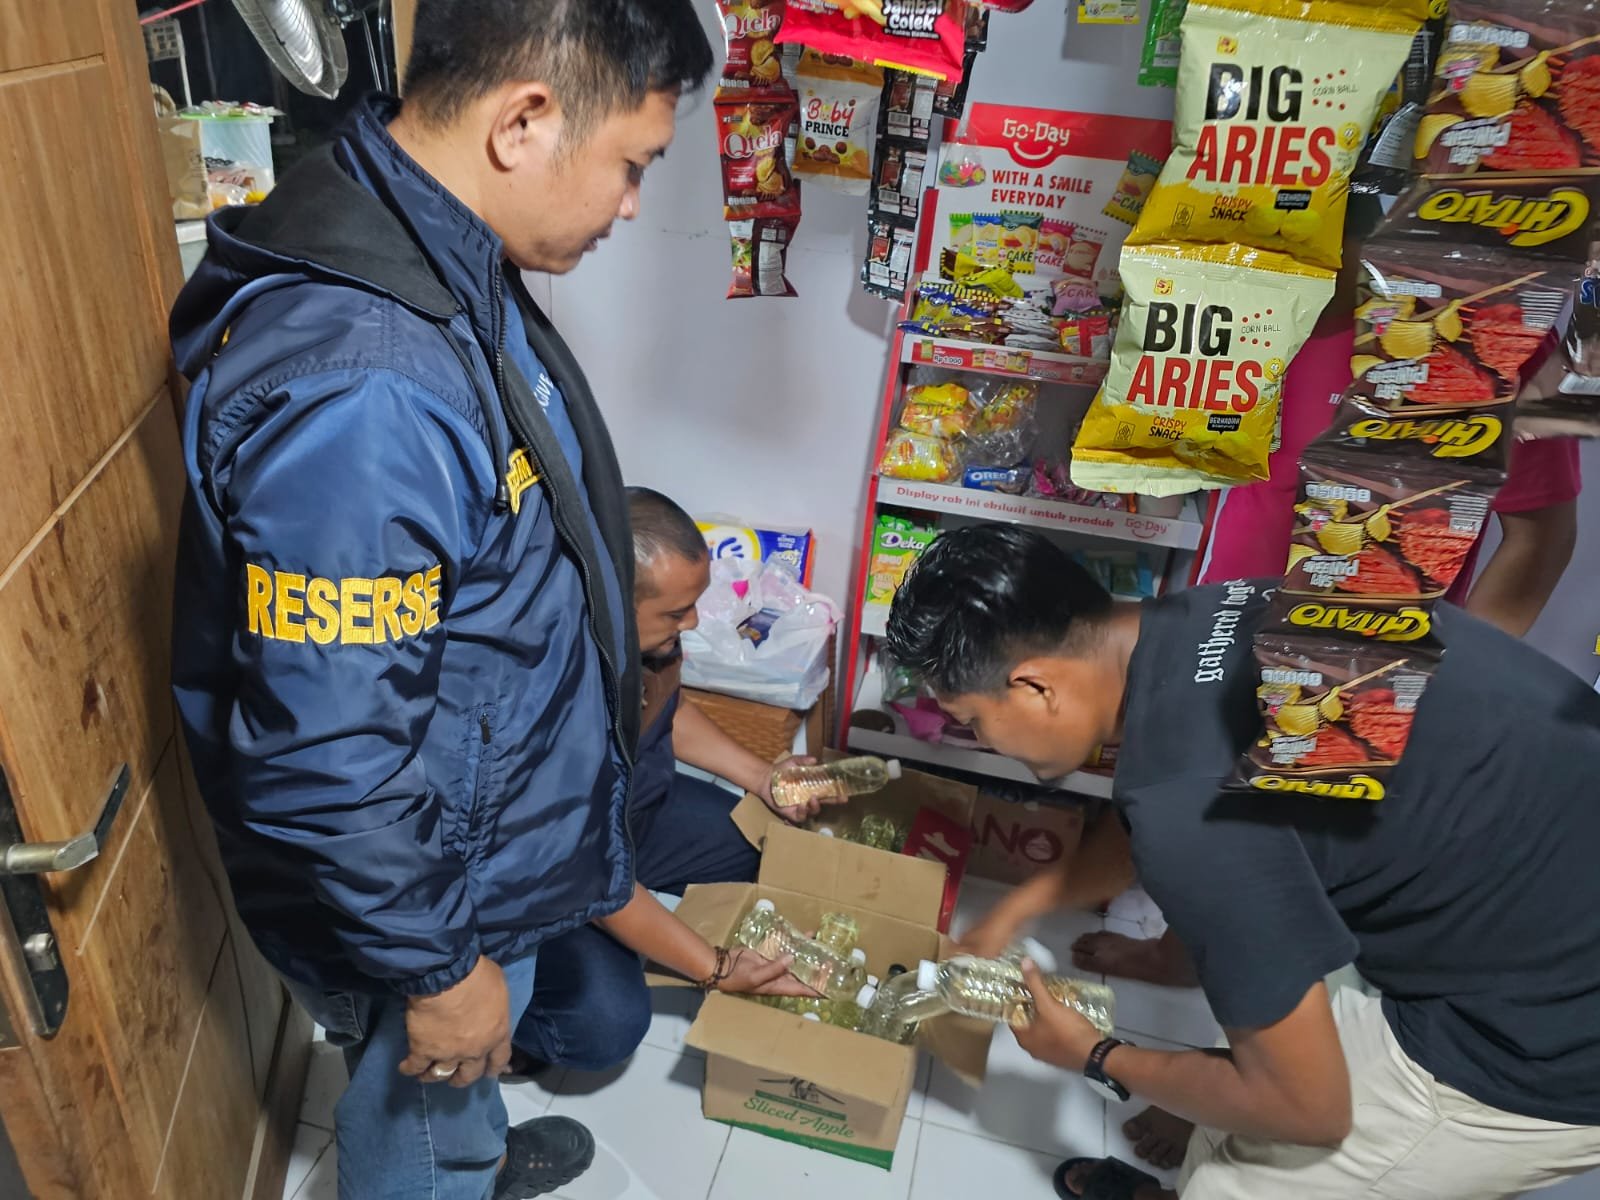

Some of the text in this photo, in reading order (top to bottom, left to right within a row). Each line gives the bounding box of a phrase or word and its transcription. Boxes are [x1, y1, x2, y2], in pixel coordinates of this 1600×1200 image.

[723, 11, 781, 40] Qtela
[888, 14, 935, 31] Colek
[1205, 62, 1303, 122] BIG
[805, 120, 850, 137] PRINCE
[1002, 118, 1070, 145] Go-Day
[724, 124, 782, 159] Qtela
[1186, 124, 1336, 188] ARIES
[992, 169, 1093, 194] WITH A SMILE
[991, 188, 1066, 209] EVERYDAY
[1214, 195, 1252, 209] CRISPY
[1209, 207, 1249, 222] SNACK
[1006, 250, 1034, 262] CAKE
[1038, 253, 1065, 267] CAKE
[1143, 301, 1233, 357] BIG
[1241, 323, 1281, 334] CORN BALL
[1126, 354, 1263, 414] ARIES
[1153, 416, 1188, 429] CRISPY
[1148, 426, 1184, 441] SNACK
[971, 471, 1008, 482] OREO
[896, 486, 941, 502] Display
[942, 491, 963, 503] rak
[965, 494, 981, 506] ini
[1029, 506, 1066, 520] untuk
[1068, 512, 1115, 528] produk
[881, 531, 926, 550] Deka
[246, 562, 443, 646] RESERSE
[743, 1097, 856, 1139] Sliced Apple
